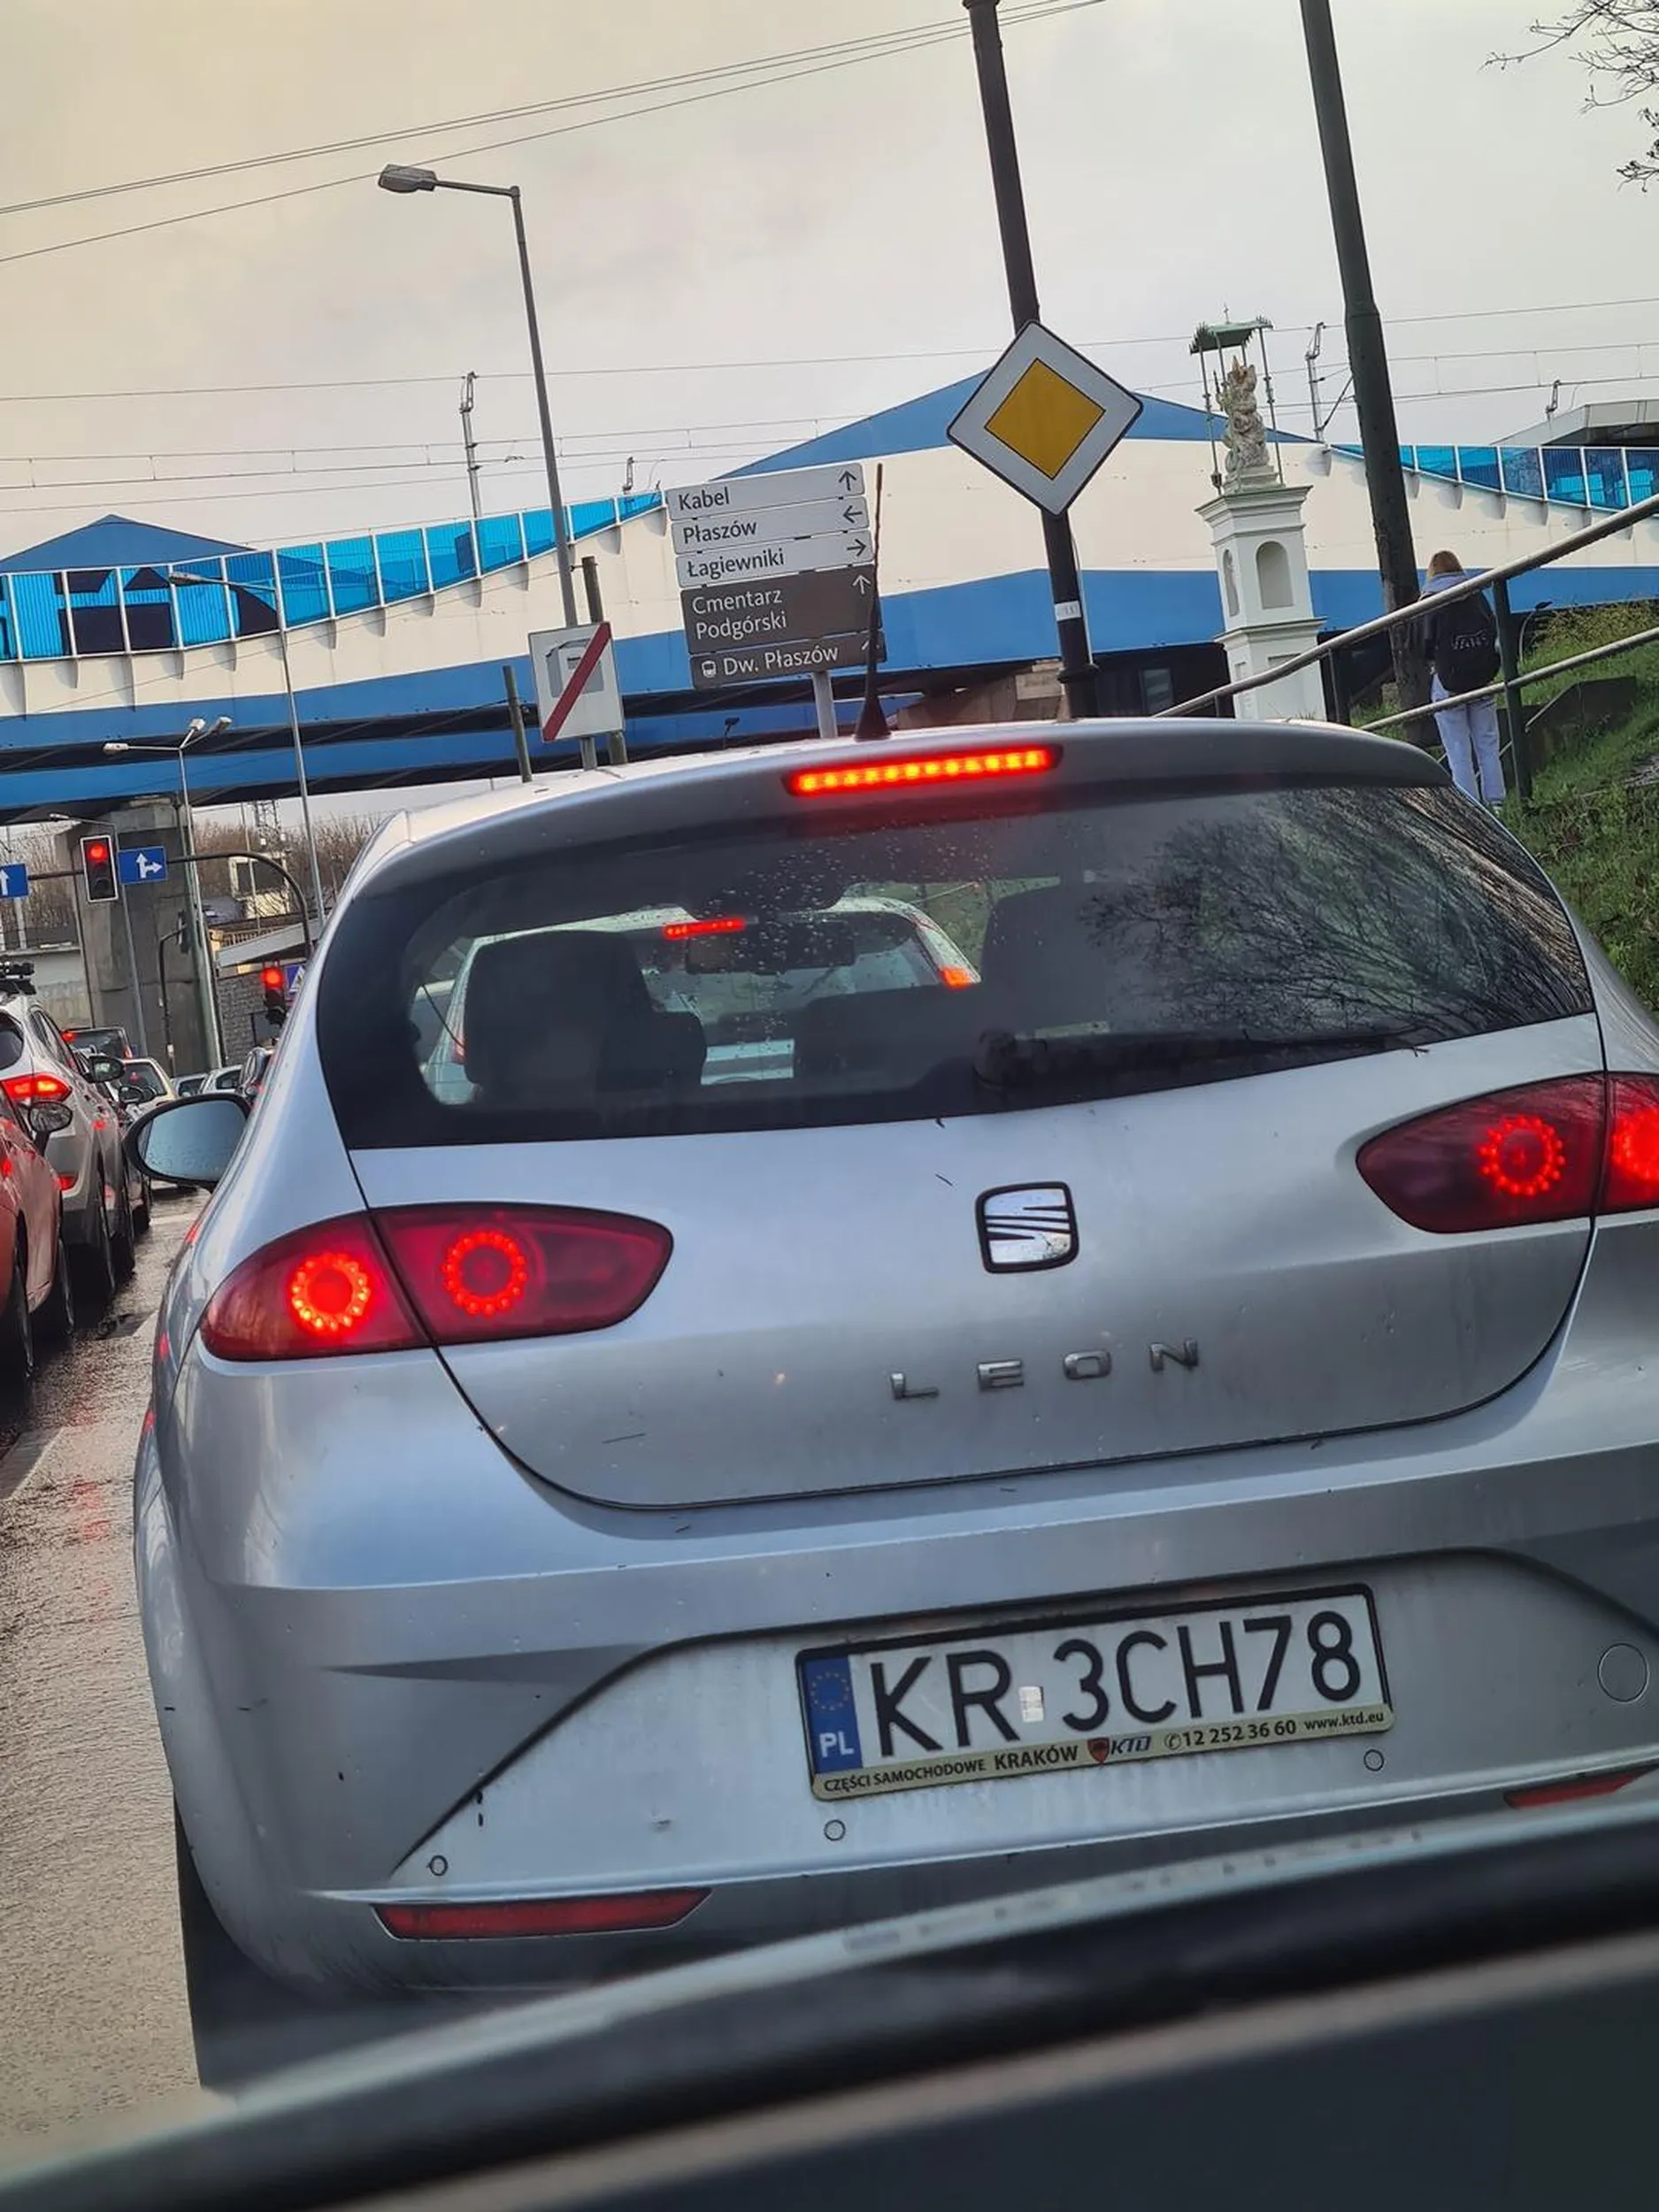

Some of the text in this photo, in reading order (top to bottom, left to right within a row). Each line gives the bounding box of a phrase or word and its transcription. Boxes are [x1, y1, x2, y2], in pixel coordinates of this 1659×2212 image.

[678, 487, 731, 511] Kabel
[682, 520, 757, 544] Płaszów
[687, 548, 785, 580] Łagiewniki
[692, 588, 783, 615] Cmentarz
[695, 611, 787, 641] Podgórski
[723, 646, 839, 676] Dw. Płaszów
[889, 1337, 1200, 1402] LEON
[870, 1609, 1362, 1758] KR 3CH78
[819, 1732, 855, 1758] PL
[823, 1773, 872, 1793] CZĘŚCI
[873, 1758, 987, 1786] SAMOCHODOWE
[994, 1744, 1079, 1770] KRAKÓW
[1182, 1729, 1205, 1747] 12
[1209, 1724, 1244, 1744] 252
[1249, 1723, 1271, 1741] 36
[1274, 1719, 1298, 1737] 60
[1303, 1710, 1386, 1732] www.ktd.eu
